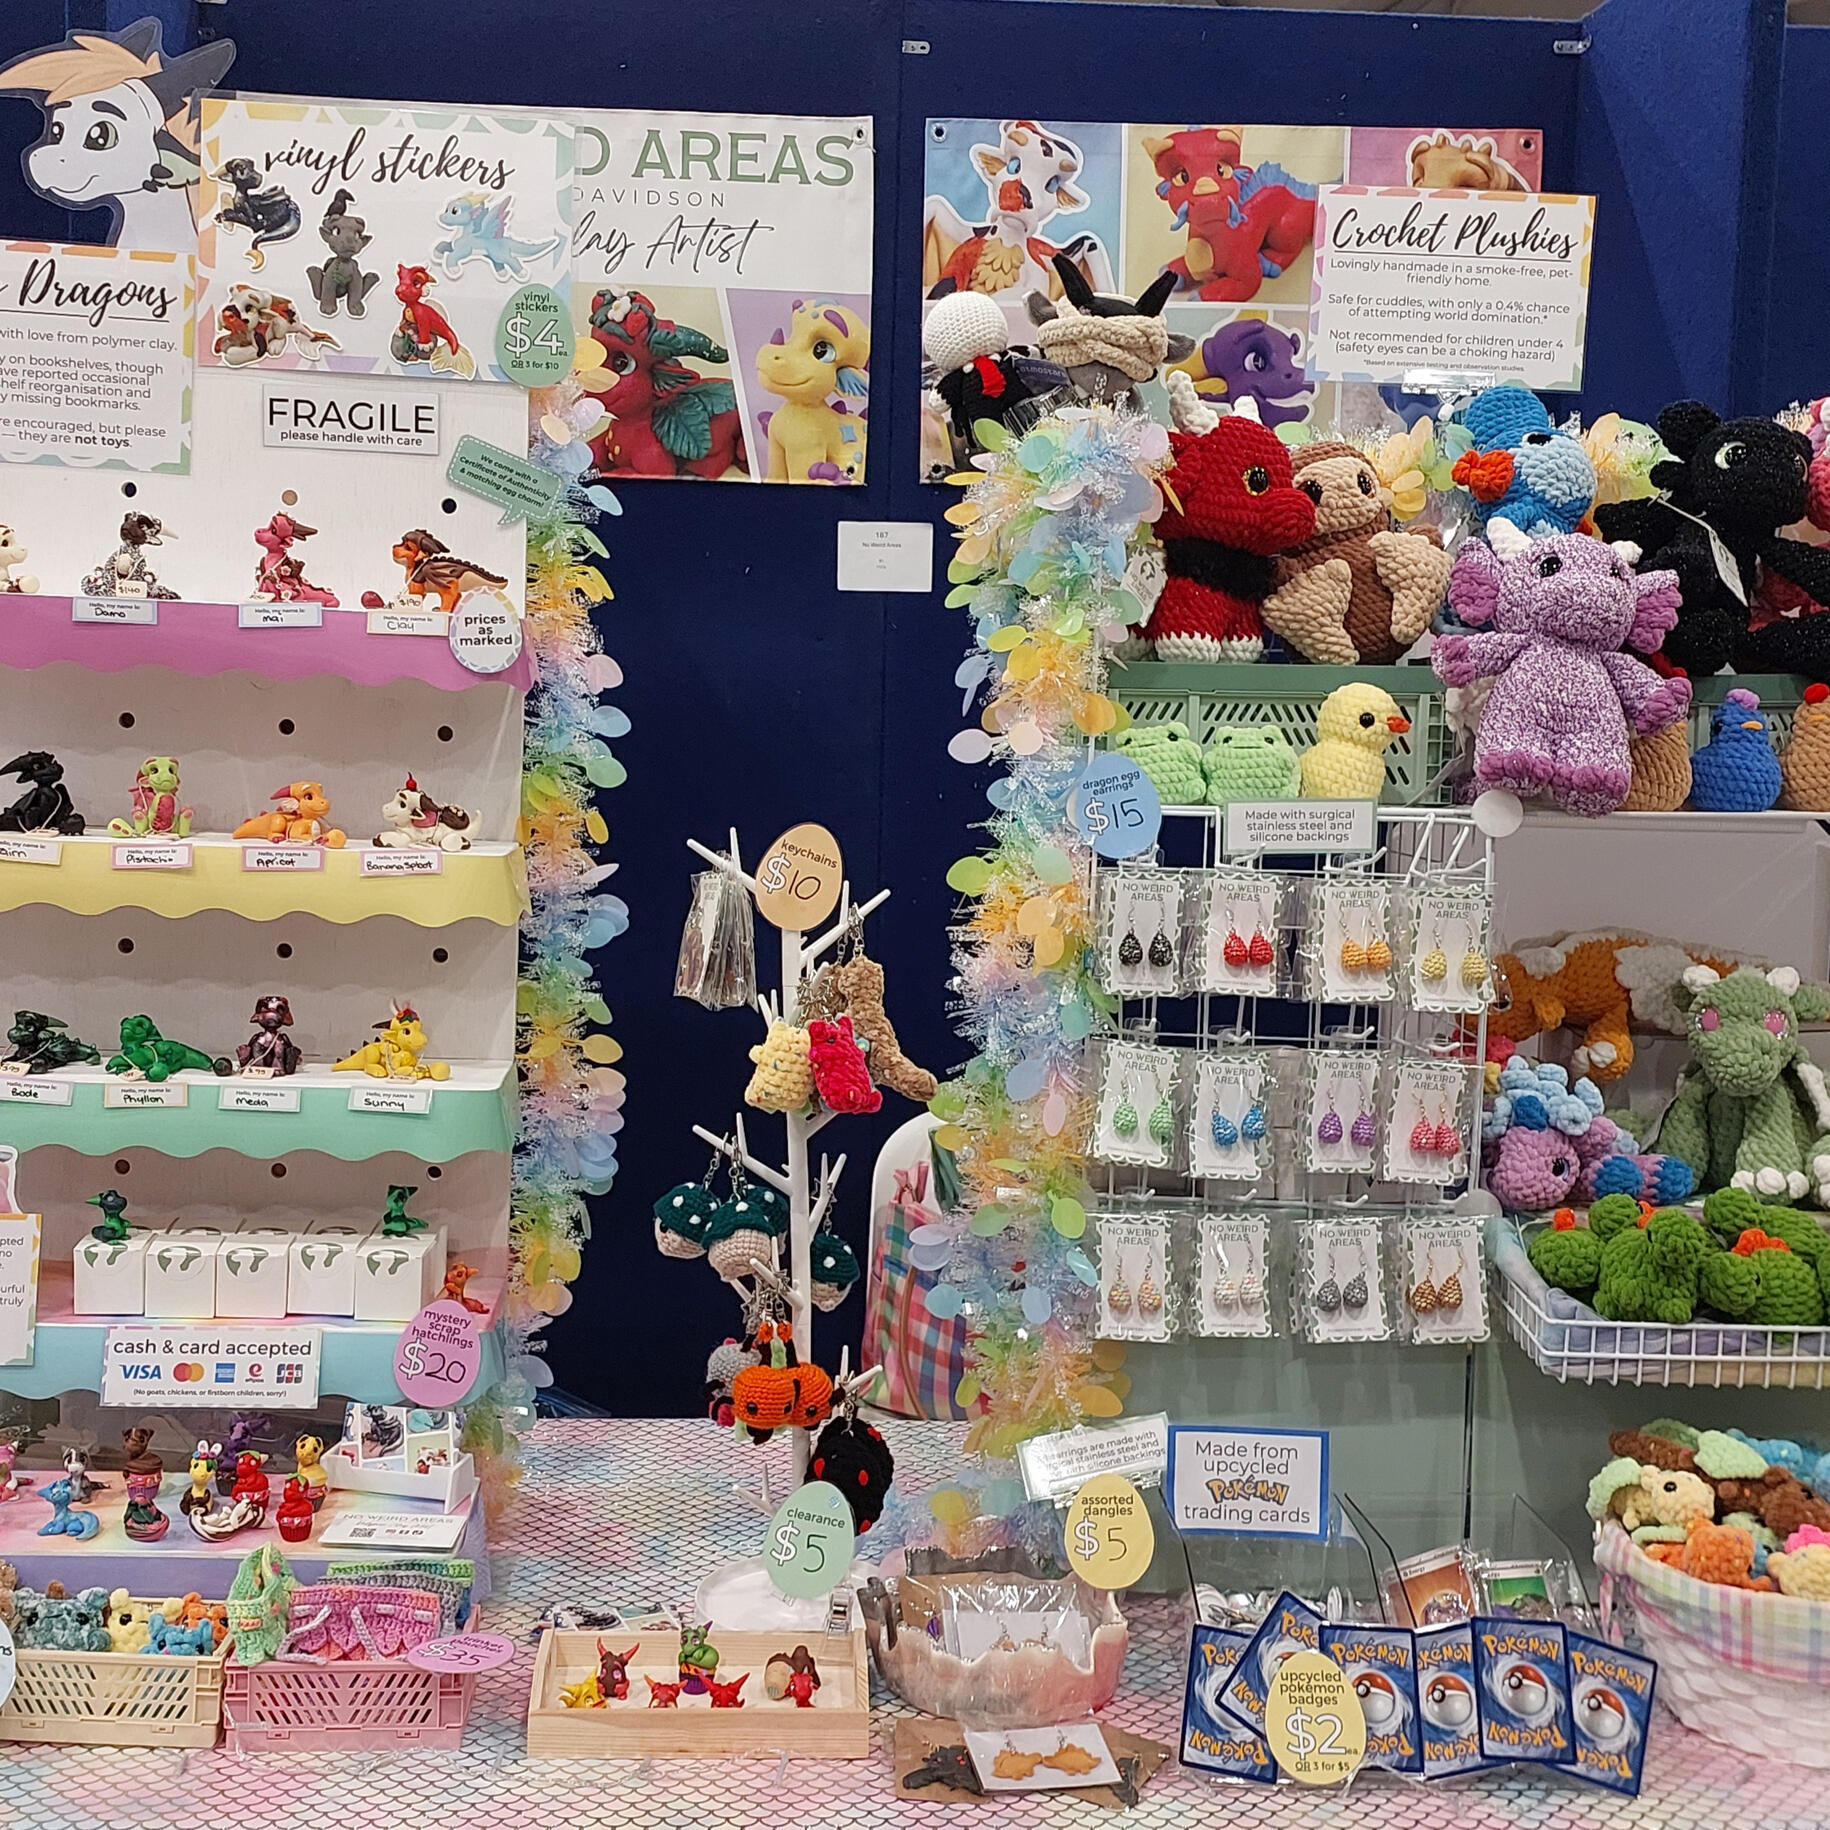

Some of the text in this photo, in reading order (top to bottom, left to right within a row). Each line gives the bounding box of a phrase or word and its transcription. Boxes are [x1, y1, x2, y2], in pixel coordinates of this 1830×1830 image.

[265, 126, 517, 195] vinyl stickers
[631, 129, 854, 186] AREAS
[573, 187, 724, 207] DAVIDSON
[1333, 201, 1579, 259] Crochet Plushies
[572, 211, 775, 274] lay Artist
[1330, 258, 1574, 281] Lovingly handmade in a smoke-free, pet-
[1407, 273, 1492, 287] friendly home.
[19, 258, 177, 327] Dragons
[523, 292, 550, 305] vinyl
[515, 301, 559, 313] stickers
[1328, 294, 1570, 314] Safe for cuddles, with only a 0.4% chance
[1349, 307, 1361, 317] of
[1363, 307, 1431, 321] attempting
[1434, 309, 1469, 321] world
[27, 330, 54, 342] love
[57, 332, 88, 344] from
[92, 335, 145, 350] polymer
[149, 338, 178, 352] clay.
[505, 311, 565, 359] $4
[1329, 329, 1564, 349] Not recommended for children under 4
[1336, 341, 1374, 356] (safety
[1377, 344, 1404, 356] eyes
[1407, 345, 1428, 355] can
[1431, 344, 1447, 356] be
[1459, 347, 1508, 361] choking
[1511, 349, 1556, 362] hazard)
[9, 356, 25, 365] on
[29, 355, 112, 372] bookshelves,
[116, 362, 164, 377] though
[511, 359, 524, 369] OR
[532, 360, 543, 369] for
[544, 361, 559, 370] $10
[22, 369, 150, 386] reported occasional
[29, 381, 151, 399] reorganisation and
[11, 392, 142, 412] missing bookmarks.
[269, 397, 436, 435] FRAGILE
[14, 418, 167, 438] encouraged, but please
[18, 430, 133, 450] they are not toys.
[280, 430, 423, 447] please handle with care
[459, 456, 552, 502] Certificate of Authenticity
[481, 454, 539, 485] We come with a
[466, 470, 502, 491] matching
[502, 487, 518, 498] egg
[518, 492, 545, 508] charm!
[465, 614, 506, 627] prices
[460, 634, 513, 646] marked
[479, 627, 493, 635] as
[1082, 771, 1140, 790] dragon egg
[1093, 781, 1135, 796] earrings
[1084, 797, 1144, 836] $15
[1245, 809, 1355, 821] Made with surgical
[1247, 820, 1353, 831] stainless steel and
[1250, 831, 1350, 843] silicone backings
[781, 839, 838, 868] keychains
[761, 852, 821, 900] $10
[1123, 883, 1174, 893] NO WEIRD
[1130, 892, 1164, 902] AREAS
[424, 1310, 471, 1329] mystery
[429, 1322, 460, 1337] scrap
[412, 1326, 474, 1349] hatchlings
[113, 1339, 312, 1358] cash & card accepted
[399, 1336, 466, 1383] $20
[119, 1364, 162, 1380] VISA
[1196, 1441, 1298, 1459] Made from
[1204, 1459, 1289, 1476] upcycled
[1081, 1494, 1133, 1505] assorted
[787, 1508, 846, 1528] clearance
[1084, 1504, 1133, 1518] dangles
[1184, 1504, 1310, 1524] trading cards
[770, 1520, 827, 1572] $5
[1074, 1515, 1126, 1561] $5
[1280, 1670, 1341, 1684] upcycled
[1289, 1693, 1338, 1707] badges
[1286, 1707, 1347, 1760] $2
[1295, 1761, 1350, 1772] OR 3 for $5
